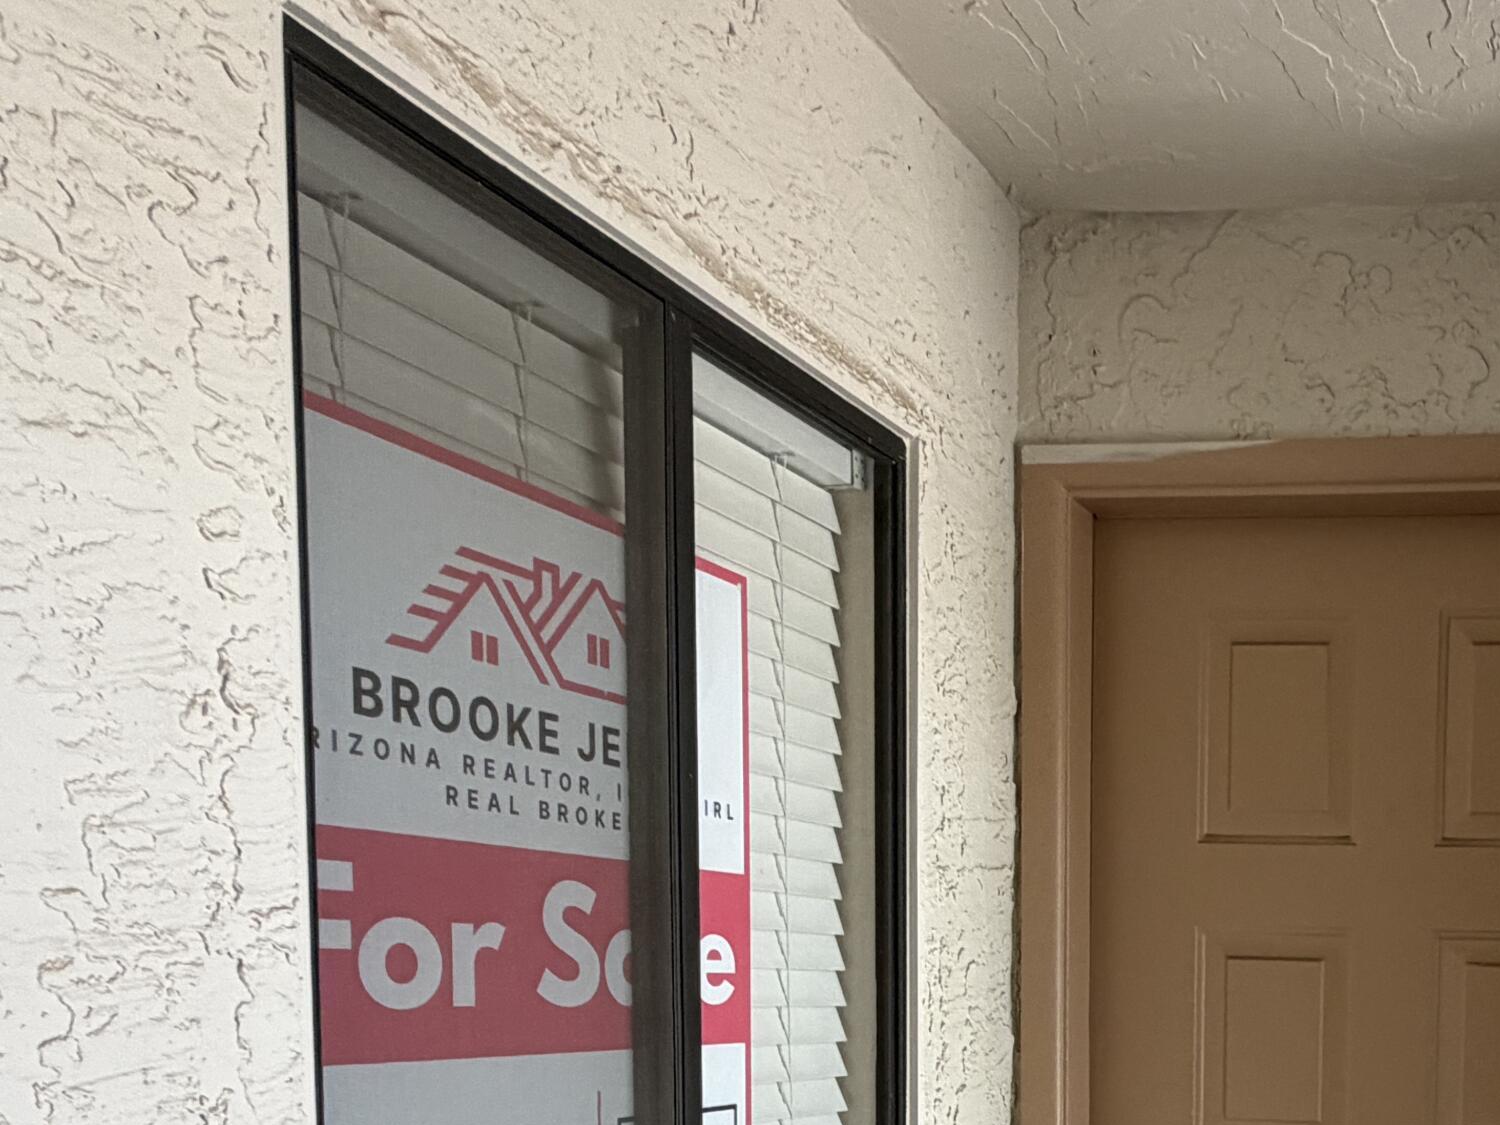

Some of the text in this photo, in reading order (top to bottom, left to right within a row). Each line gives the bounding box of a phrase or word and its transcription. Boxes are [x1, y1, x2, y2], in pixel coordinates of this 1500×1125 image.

[352, 666, 560, 756] BROOKE
[445, 785, 520, 815] REAL
[462, 754, 600, 800] REALTOR,
